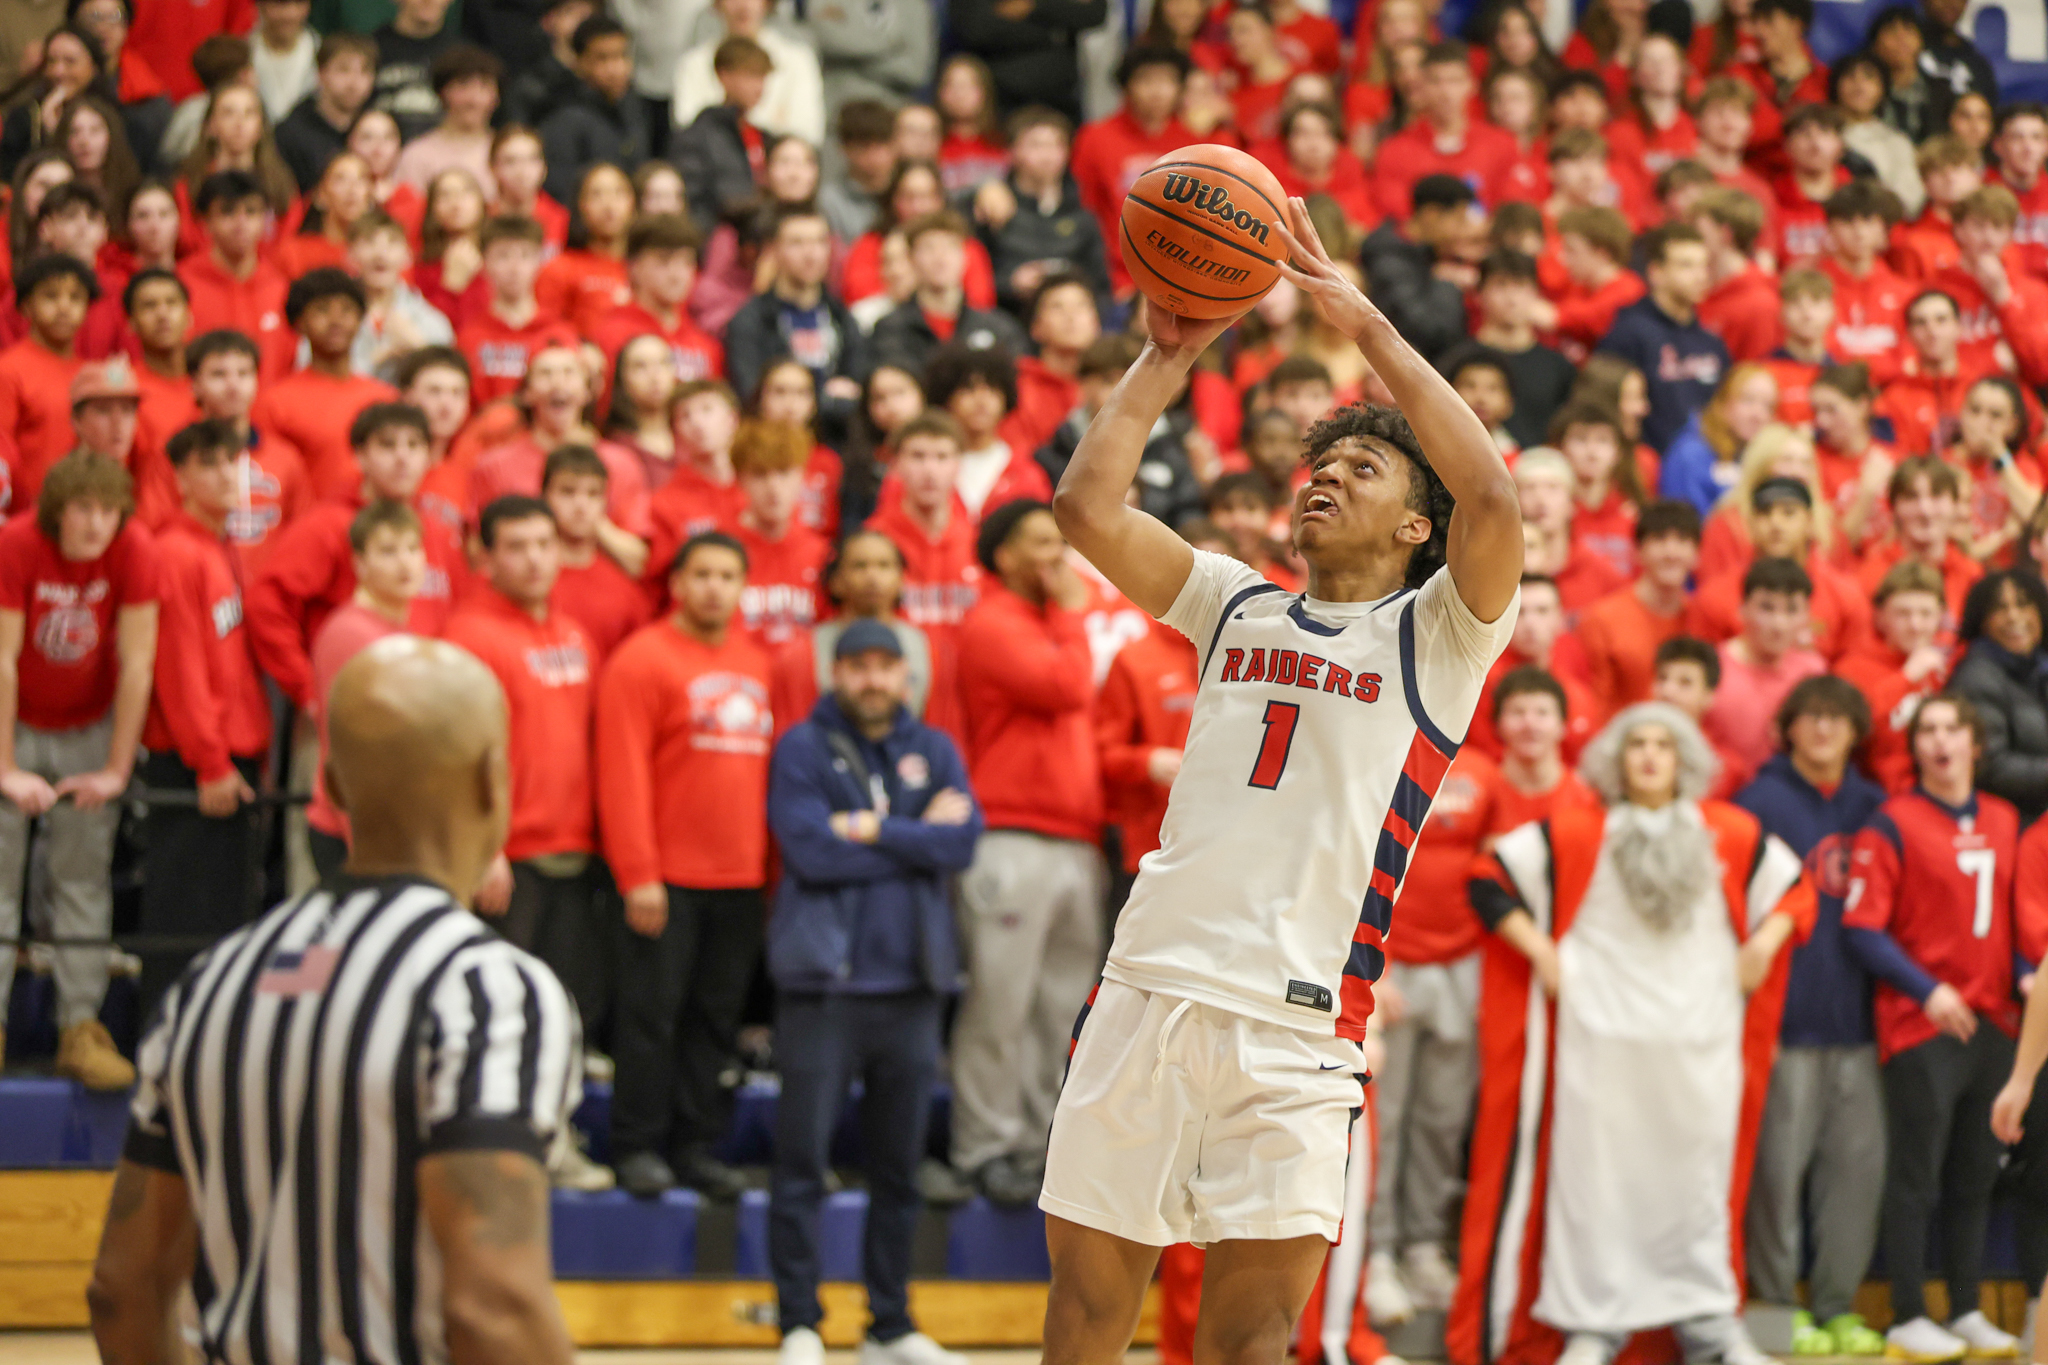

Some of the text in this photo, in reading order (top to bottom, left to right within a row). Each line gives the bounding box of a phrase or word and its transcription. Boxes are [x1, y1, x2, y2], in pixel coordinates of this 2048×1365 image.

[1163, 172, 1269, 246] Wilson
[1225, 226, 1238, 235] BALL
[1146, 229, 1252, 283] EVOLUTION
[1220, 648, 1383, 704] RAIDERS
[1247, 699, 1300, 791] 1
[1955, 848, 1996, 940] 7
[1320, 993, 1329, 1005] M
